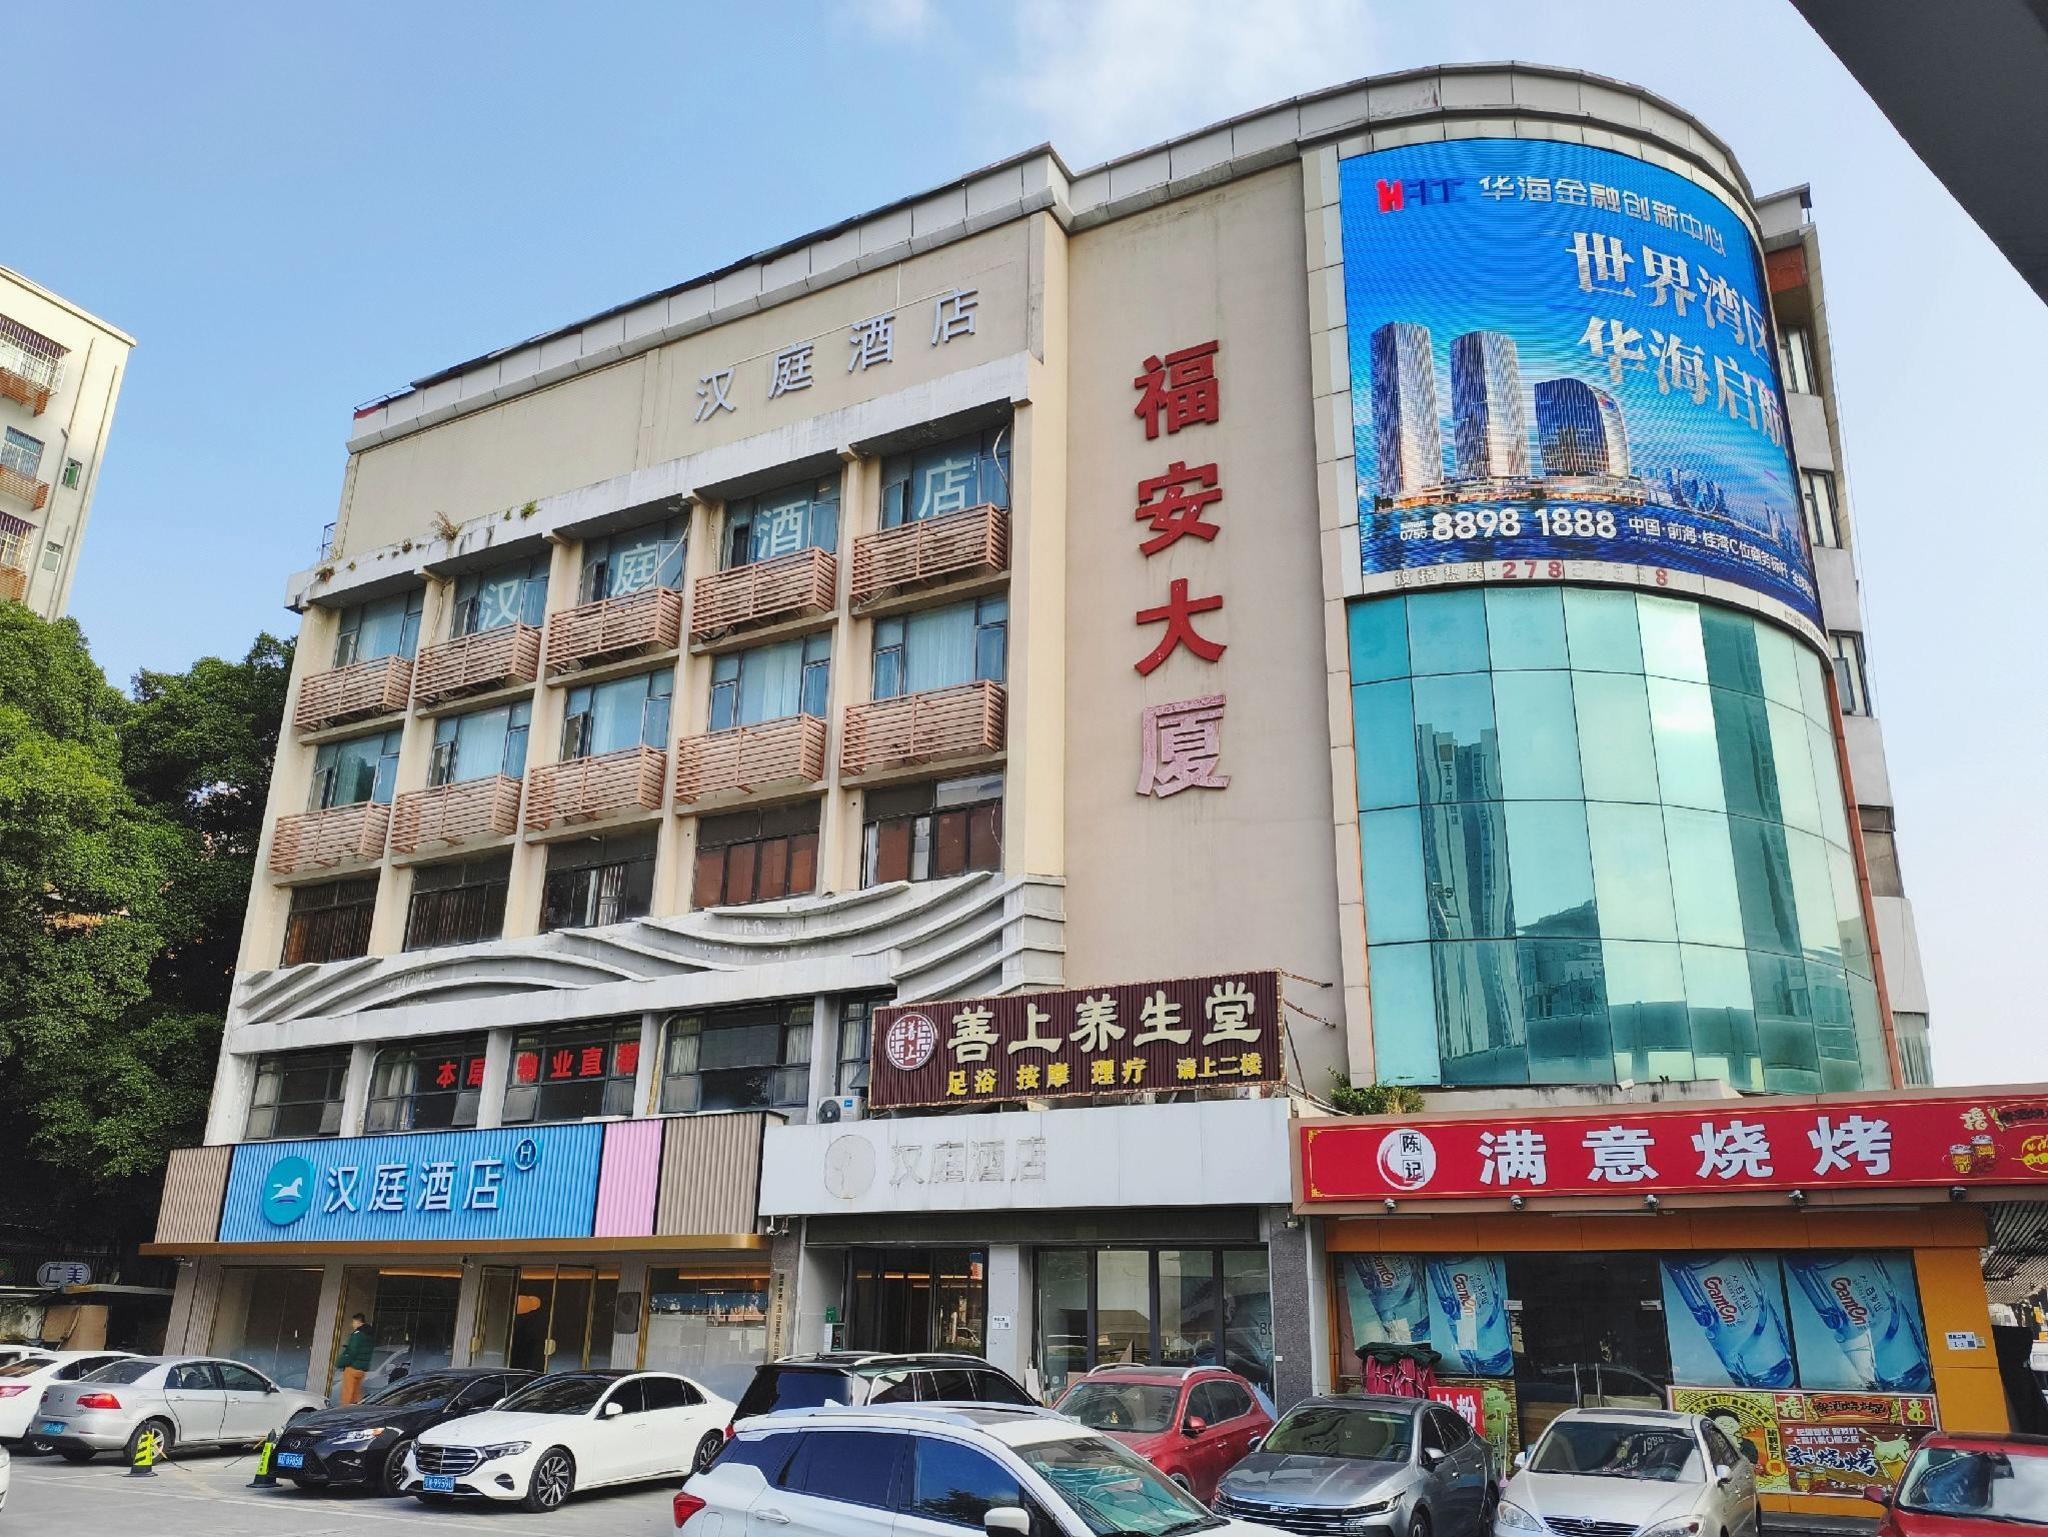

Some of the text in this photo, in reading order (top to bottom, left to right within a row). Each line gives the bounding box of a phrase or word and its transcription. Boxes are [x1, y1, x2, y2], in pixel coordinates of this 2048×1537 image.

[1478, 174, 1727, 258] 华海金融创新中心
[1565, 231, 1771, 368] 世界湾区
[693, 287, 979, 422] 汉庭酒店
[1535, 507, 1617, 539] 1888
[1134, 339, 1232, 798] 福安大厦
[946, 981, 1263, 1064] 善上养生堂
[946, 1052, 1263, 1097] 足浴 按摩 理疗 请上二楼
[323, 1156, 504, 1215] 汉庭酒店
[1401, 1131, 1425, 1182] 陈记
[1477, 1114, 1895, 1187] 满意烧烤
